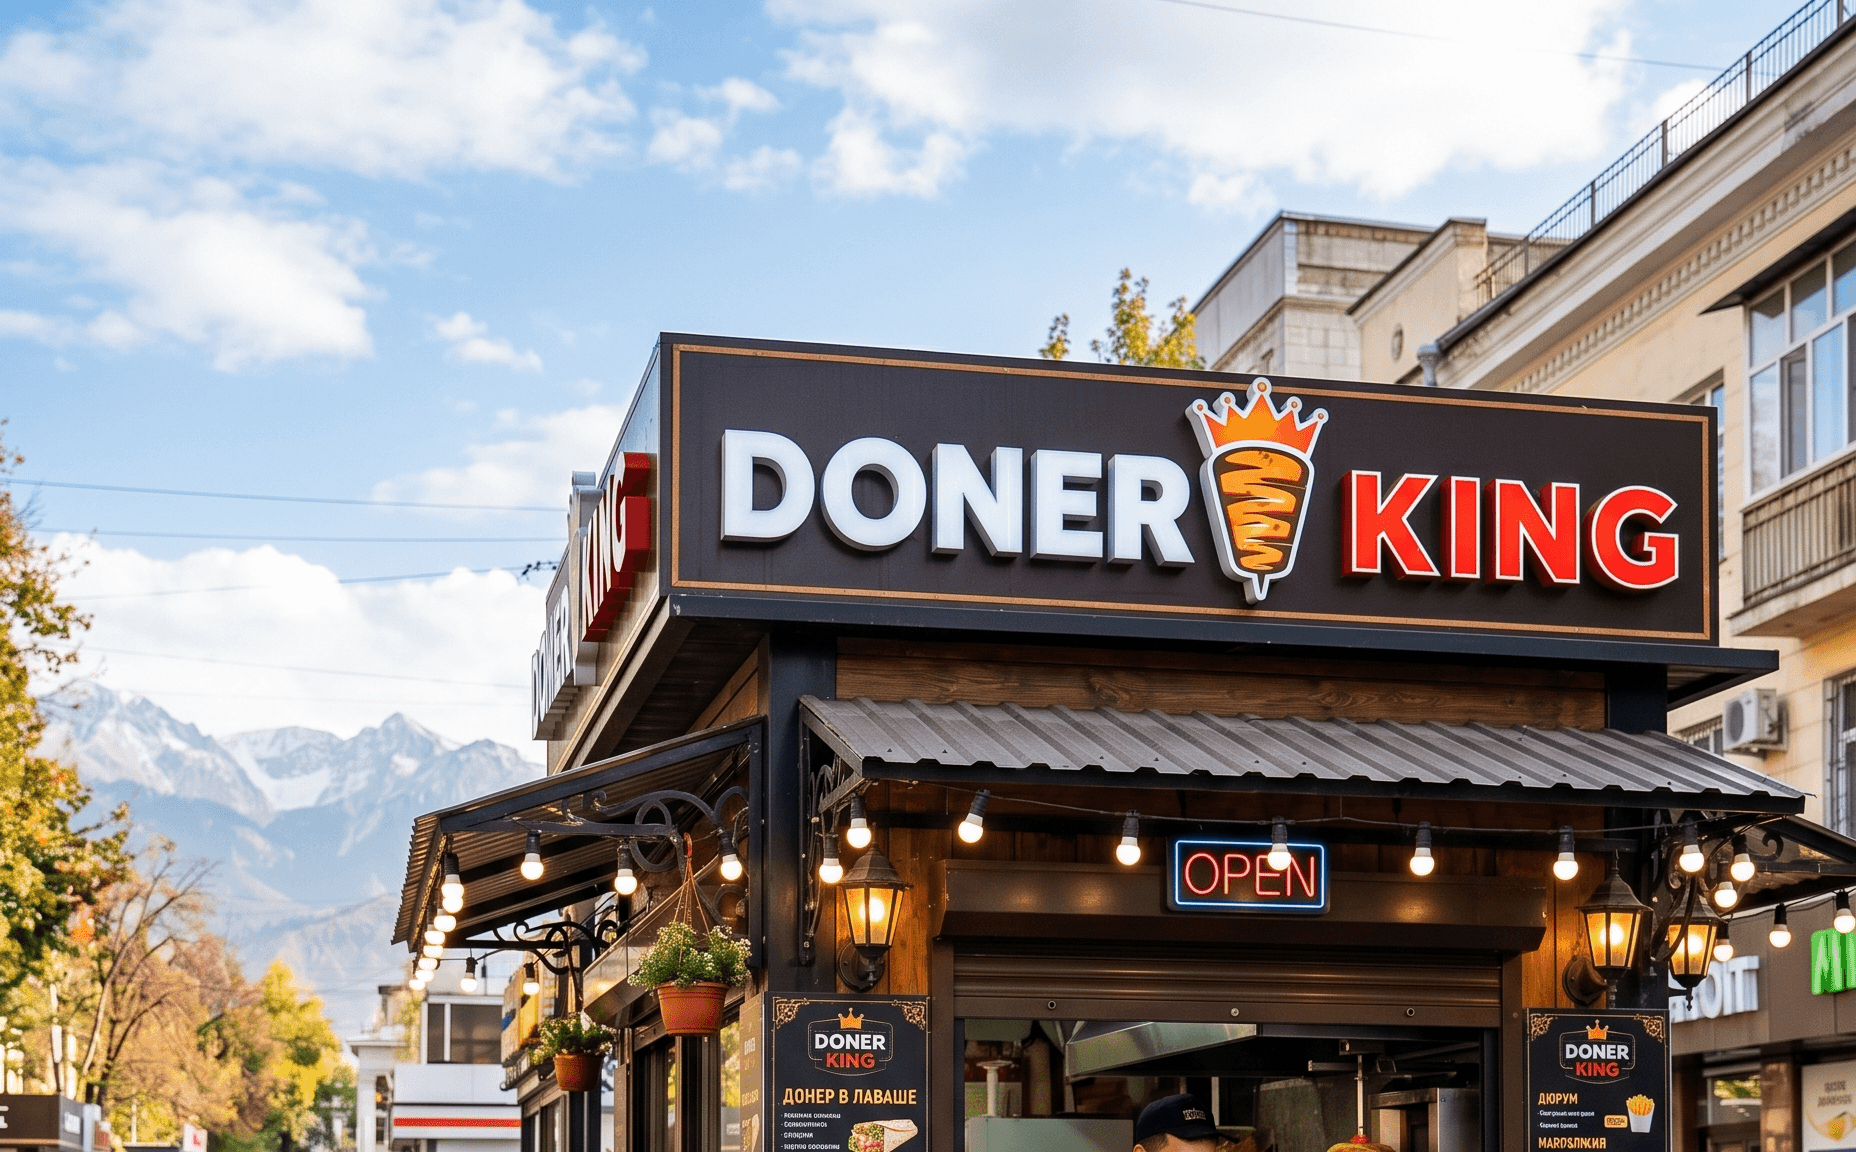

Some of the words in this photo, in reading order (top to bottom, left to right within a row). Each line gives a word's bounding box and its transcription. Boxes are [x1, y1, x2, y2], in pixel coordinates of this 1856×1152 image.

[720, 428, 1196, 568] DONER
[1341, 469, 1681, 590] KING
[582, 451, 640, 643] KING
[1185, 852, 1315, 897] OPEN
[815, 1033, 886, 1051] DONER
[1565, 1043, 1630, 1060] DONER
[825, 1053, 875, 1069] KING
[1575, 1061, 1620, 1077] KING
[782, 1088, 835, 1105] ДОНЕР
[839, 1089, 849, 1104] В
[853, 1089, 917, 1105] ЛАВАШЕ
[1537, 1092, 1578, 1105] ДЮРУМ
